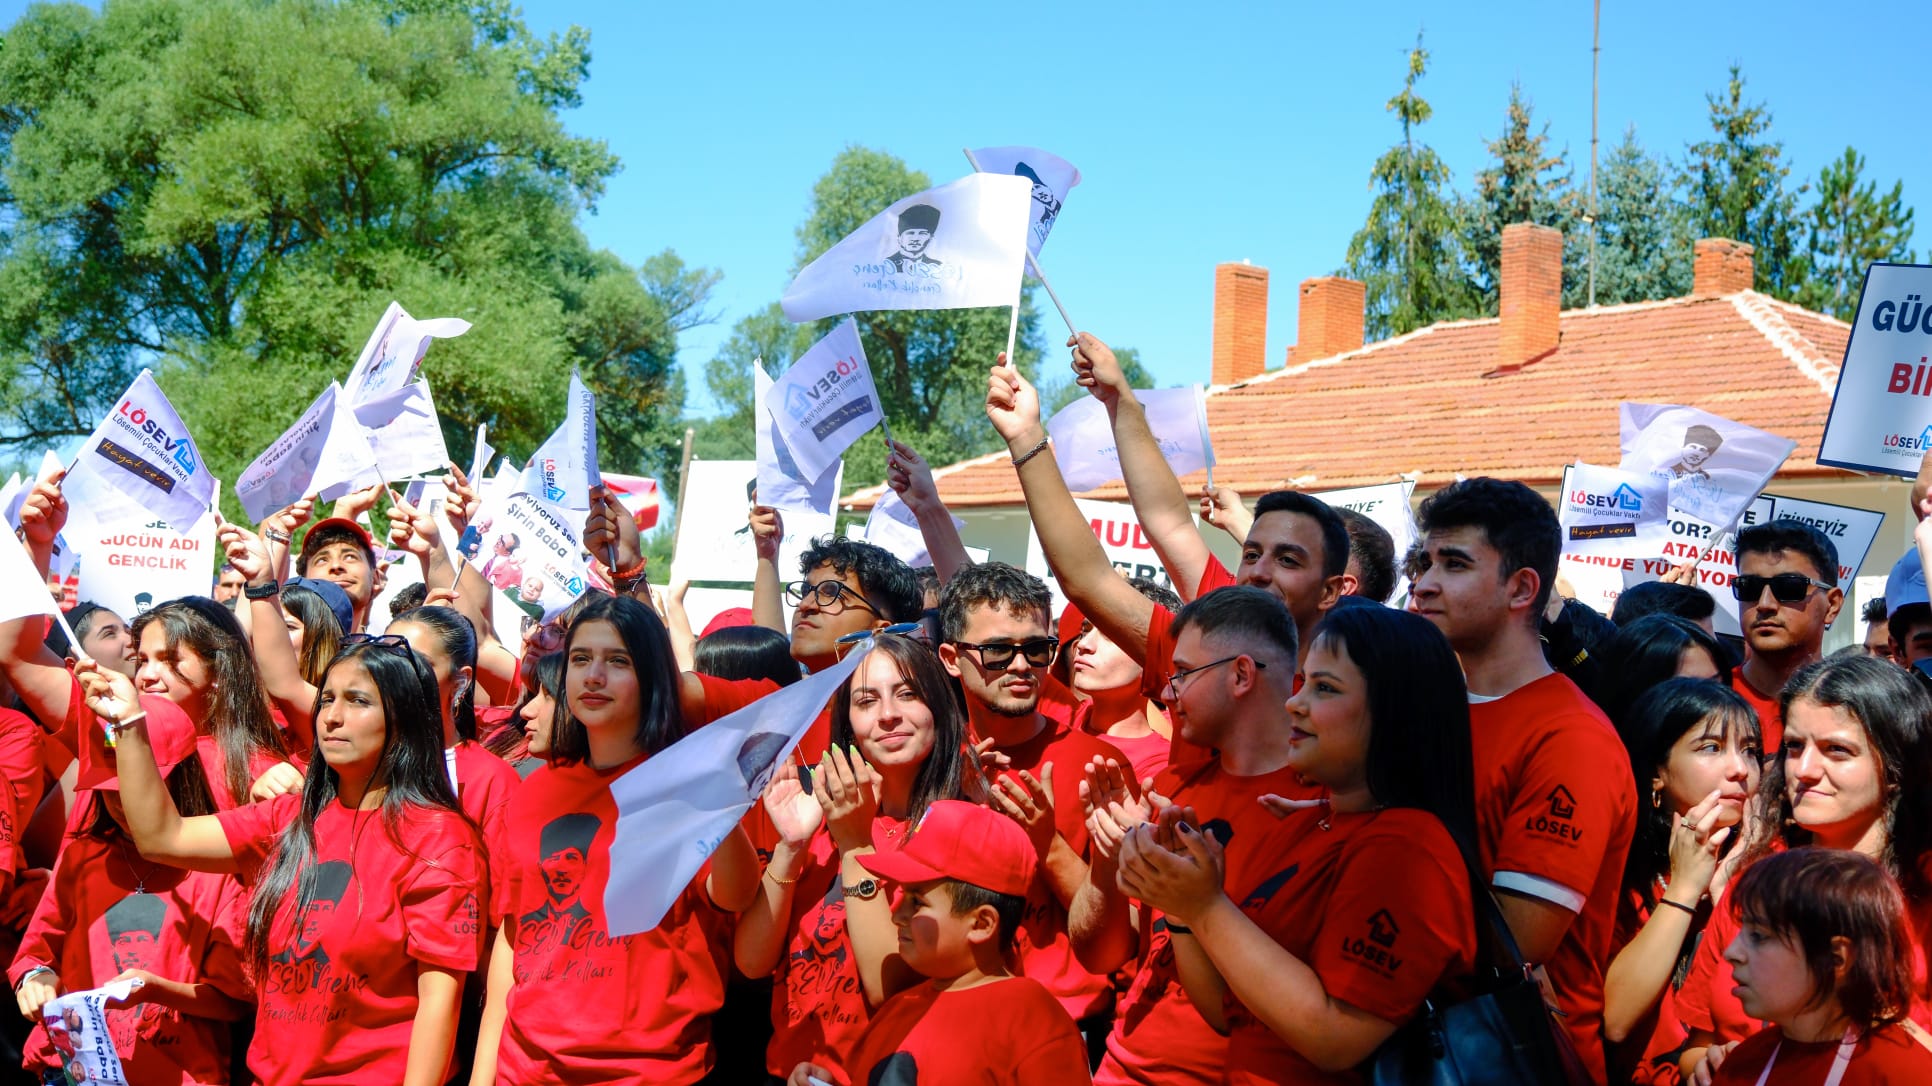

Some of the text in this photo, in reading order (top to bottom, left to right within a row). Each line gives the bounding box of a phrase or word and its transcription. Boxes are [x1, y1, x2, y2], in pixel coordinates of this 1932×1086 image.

[119, 400, 179, 452] LÖSEV
[112, 413, 188, 483] Lösemili Çocuklar Vakfı
[1884, 434, 1922, 450] LÖSEV
[101, 441, 171, 487] Hayat verir
[1569, 490, 1619, 509] LÖSEV
[1592, 508, 1622, 517] Çocuklar
[507, 502, 568, 558] Şirin Baba
[561, 527, 578, 548] Sen
[1571, 526, 1633, 538] Hayat verir
[1670, 520, 1712, 540] OR?
[169, 537, 199, 552] ADI
[1662, 541, 1736, 567] ATASIN
[544, 563, 572, 587] LÖSEV
[1525, 816, 1584, 842] LÖSEV
[453, 920, 481, 935] LÖS
[1342, 936, 1403, 972] LÖSEV
[95, 1036, 108, 1079] Baba
